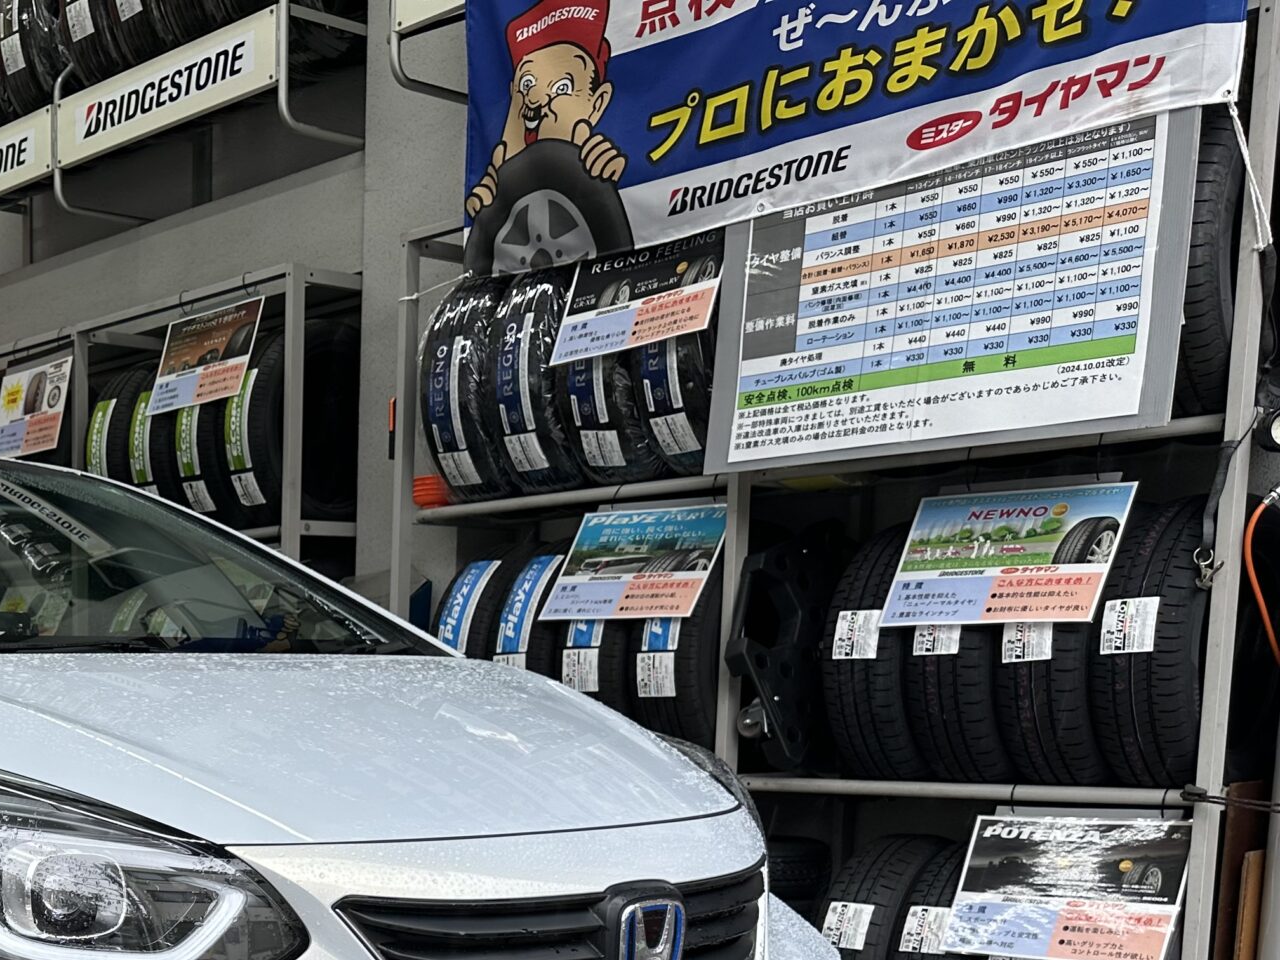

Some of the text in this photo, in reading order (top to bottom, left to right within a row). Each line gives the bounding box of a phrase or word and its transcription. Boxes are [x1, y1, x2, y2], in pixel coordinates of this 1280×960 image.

[515, 7, 600, 42] BRIDGESTONE
[83, 41, 246, 140] BRIDGESTONE
[920, 55, 1166, 144] ミスター タイヤマン
[667, 144, 852, 217] BRIDGESTONE
[885, 202, 897, 212] 1本
[920, 193, 939, 203] ¥550
[958, 184, 978, 194] ¥550
[999, 175, 1020, 186] ¥550
[882, 238, 894, 247] 1本
[918, 229, 936, 239] ¥550
[955, 221, 975, 231] ¥660
[996, 212, 1017, 223] ¥990
[884, 220, 896, 229] 1本
[919, 211, 938, 221] ¥550
[957, 202, 977, 212] ¥660
[997, 194, 1018, 204] ¥990
[591, 231, 717, 274] REGNO FEELING
[880, 272, 891, 281] 1本
[914, 264, 933, 274] ¥825
[952, 257, 973, 267] ¥825
[992, 249, 1014, 260] ¥825
[1037, 240, 1058, 251] ¥825
[1079, 232, 1101, 243] ¥825
[1109, 224, 1139, 237] ¥1,100
[881, 255, 893, 264] 1本
[910, 246, 935, 258] ¥1,650
[947, 239, 975, 250] ¥1,870
[987, 231, 1015, 243] ¥2,530
[878, 290, 890, 299] 1本
[944, 275, 972, 286] ¥4,400
[873, 342, 885, 351] 1本
[908, 335, 927, 345] ¥440
[945, 329, 965, 338] ¥440
[986, 322, 1007, 332] ¥440
[1029, 315, 1051, 326] ¥990
[1072, 308, 1094, 319] ¥990
[1115, 301, 1138, 312] ¥990
[876, 308, 888, 316] 1本
[806, 332, 855, 345] ローテーション
[874, 325, 887, 334] 1本
[871, 359, 882, 368] 1本
[906, 352, 925, 362] ¥330
[943, 347, 964, 357] ¥330
[983, 340, 1004, 350] ¥330
[1028, 334, 1049, 344] ¥330
[1070, 327, 1092, 338] ¥330
[1114, 321, 1137, 332] ¥330
[502, 322, 517, 397] REGNO
[435, 345, 447, 417] REGNO
[744, 378, 854, 406] 安全点検、100km点検
[968, 506, 1048, 522] NEWNO
[443, 580, 471, 641] Playz
[504, 579, 531, 639] Playz
[1114, 604, 1127, 647] NEWNO
[845, 614, 856, 654] NEWNO
[925, 625, 934, 649] NEW
[1015, 623, 1023, 656] NEWN
[982, 825, 1101, 843] POTENZA
